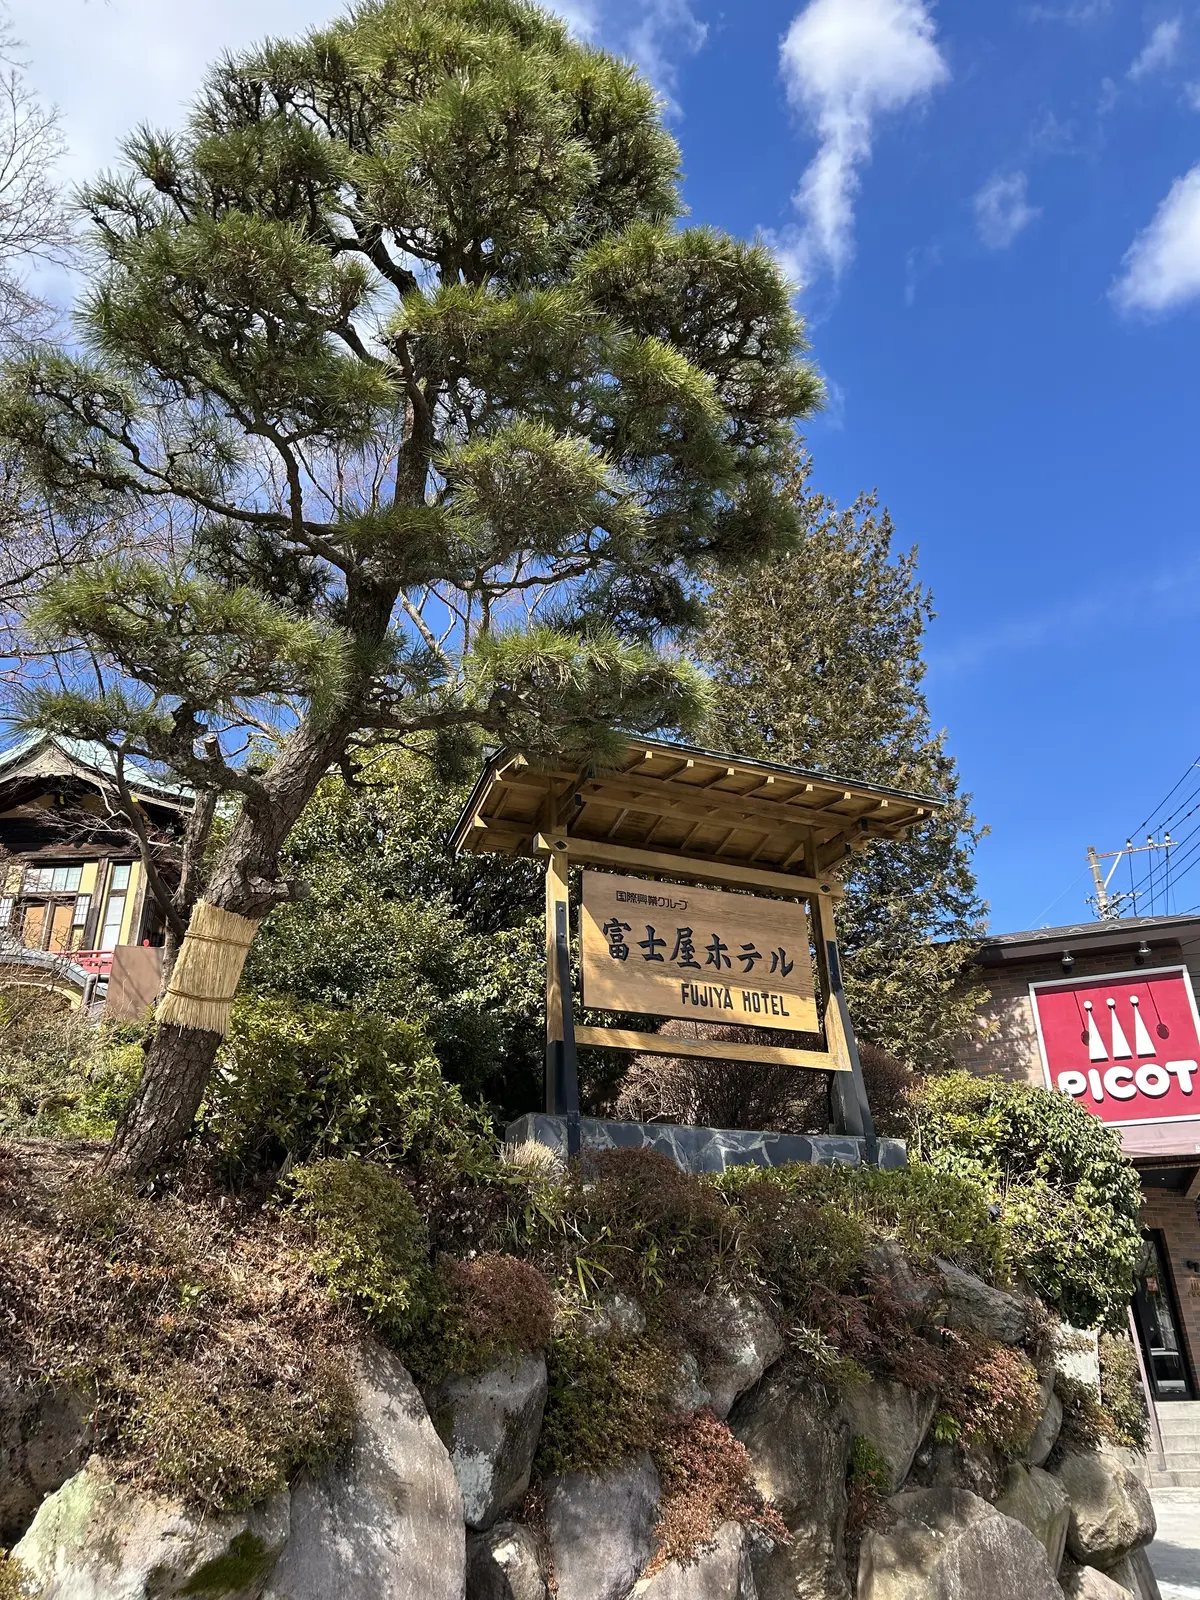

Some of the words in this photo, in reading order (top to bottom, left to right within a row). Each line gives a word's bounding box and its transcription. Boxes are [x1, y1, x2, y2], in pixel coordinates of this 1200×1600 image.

[603, 917, 794, 978] 富士屋ホテル
[681, 983, 734, 1010] FUJIYA
[742, 990, 790, 1016] HOTEL
[1057, 1059, 1198, 1102] PICOT
